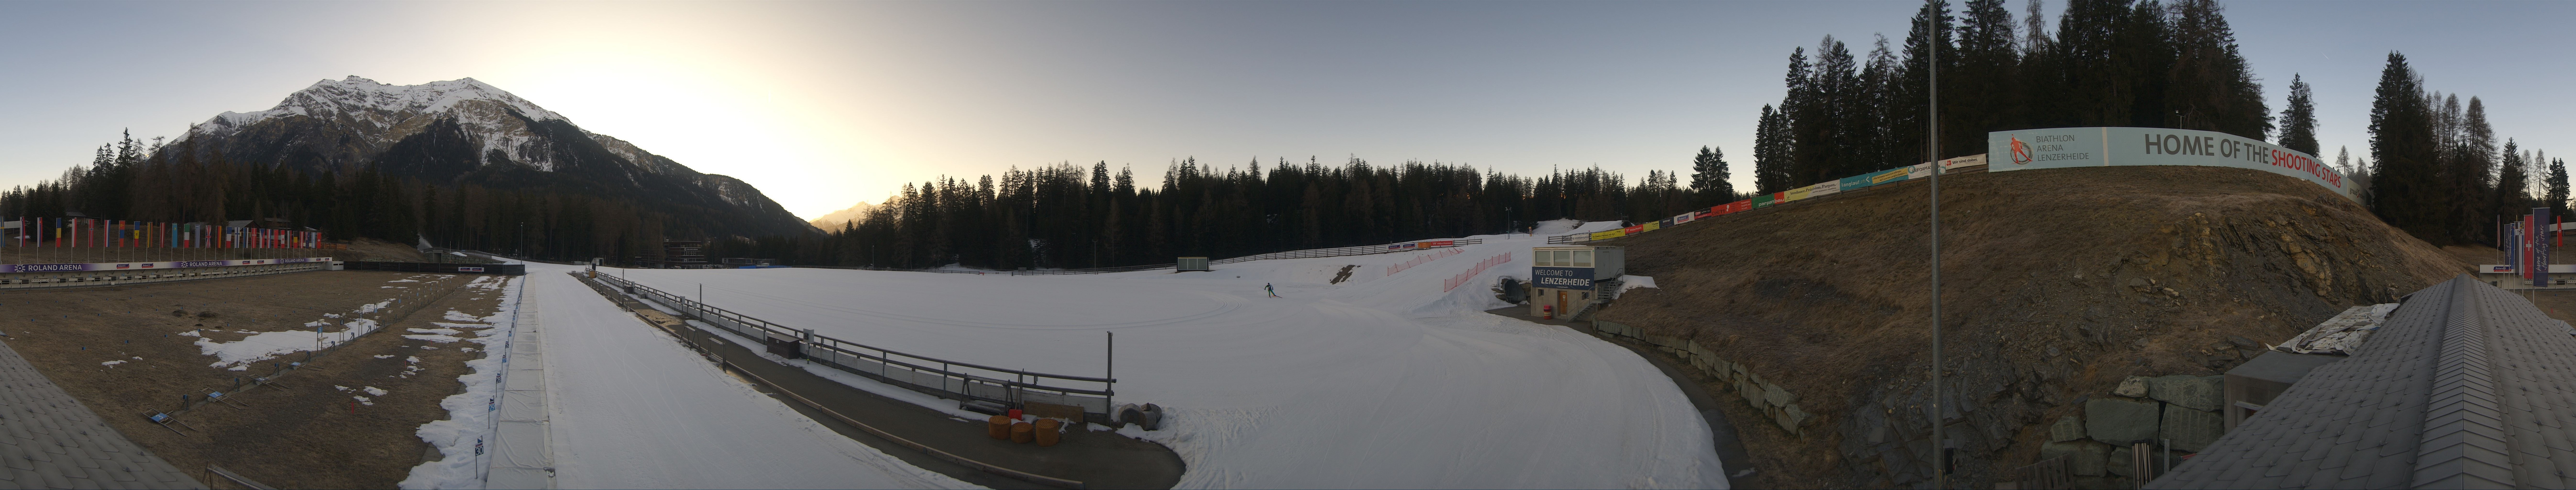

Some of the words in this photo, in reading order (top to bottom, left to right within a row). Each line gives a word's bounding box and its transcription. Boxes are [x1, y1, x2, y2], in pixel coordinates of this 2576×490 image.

[2038, 153, 2089, 161] LENZERHEIDE
[2145, 134, 2214, 156] HOME
[2221, 139, 2240, 159] OF
[2244, 142, 2268, 164] THE
[2272, 149, 2320, 177] SHOOTING
[2322, 168, 2341, 188] STARS
[1759, 198, 1784, 207] parpanbau
[1541, 277, 1590, 286] LENZERHEIDE
[476, 446, 483, 455] 30
